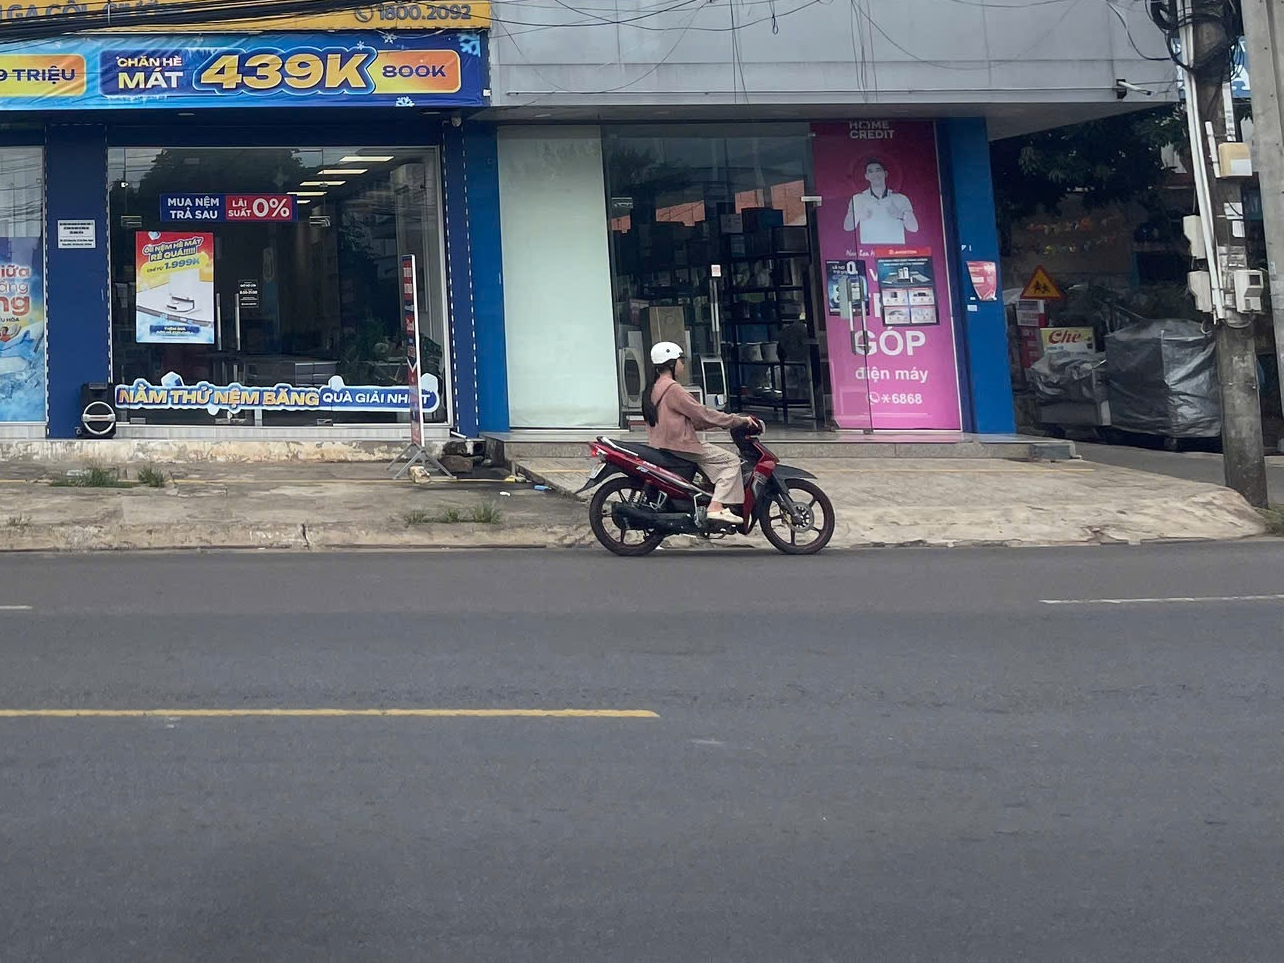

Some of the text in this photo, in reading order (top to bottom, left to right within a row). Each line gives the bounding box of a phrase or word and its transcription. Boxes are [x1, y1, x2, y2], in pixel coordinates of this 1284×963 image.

[379, 3, 471, 21] 1800.2092
[118, 54, 183, 67] CHĂN HÈ
[12, 65, 76, 85] TRIỆU
[118, 68, 183, 89] MÁT
[201, 53, 370, 89] 439K
[382, 64, 448, 78] 800K
[849, 120, 895, 139] HOME CREDIT
[167, 195, 219, 209] MUA NỆM
[232, 199, 247, 207] LÃI
[252, 198, 290, 217] 0%
[170, 207, 218, 219] TRẢ SAU
[854, 326, 926, 356] GÓP
[855, 366, 928, 383] điện máy
[214, 388, 259, 408] NỆM
[262, 387, 319, 405] BĂNG
[322, 391, 430, 404] QUÀ GIẢI NHT
